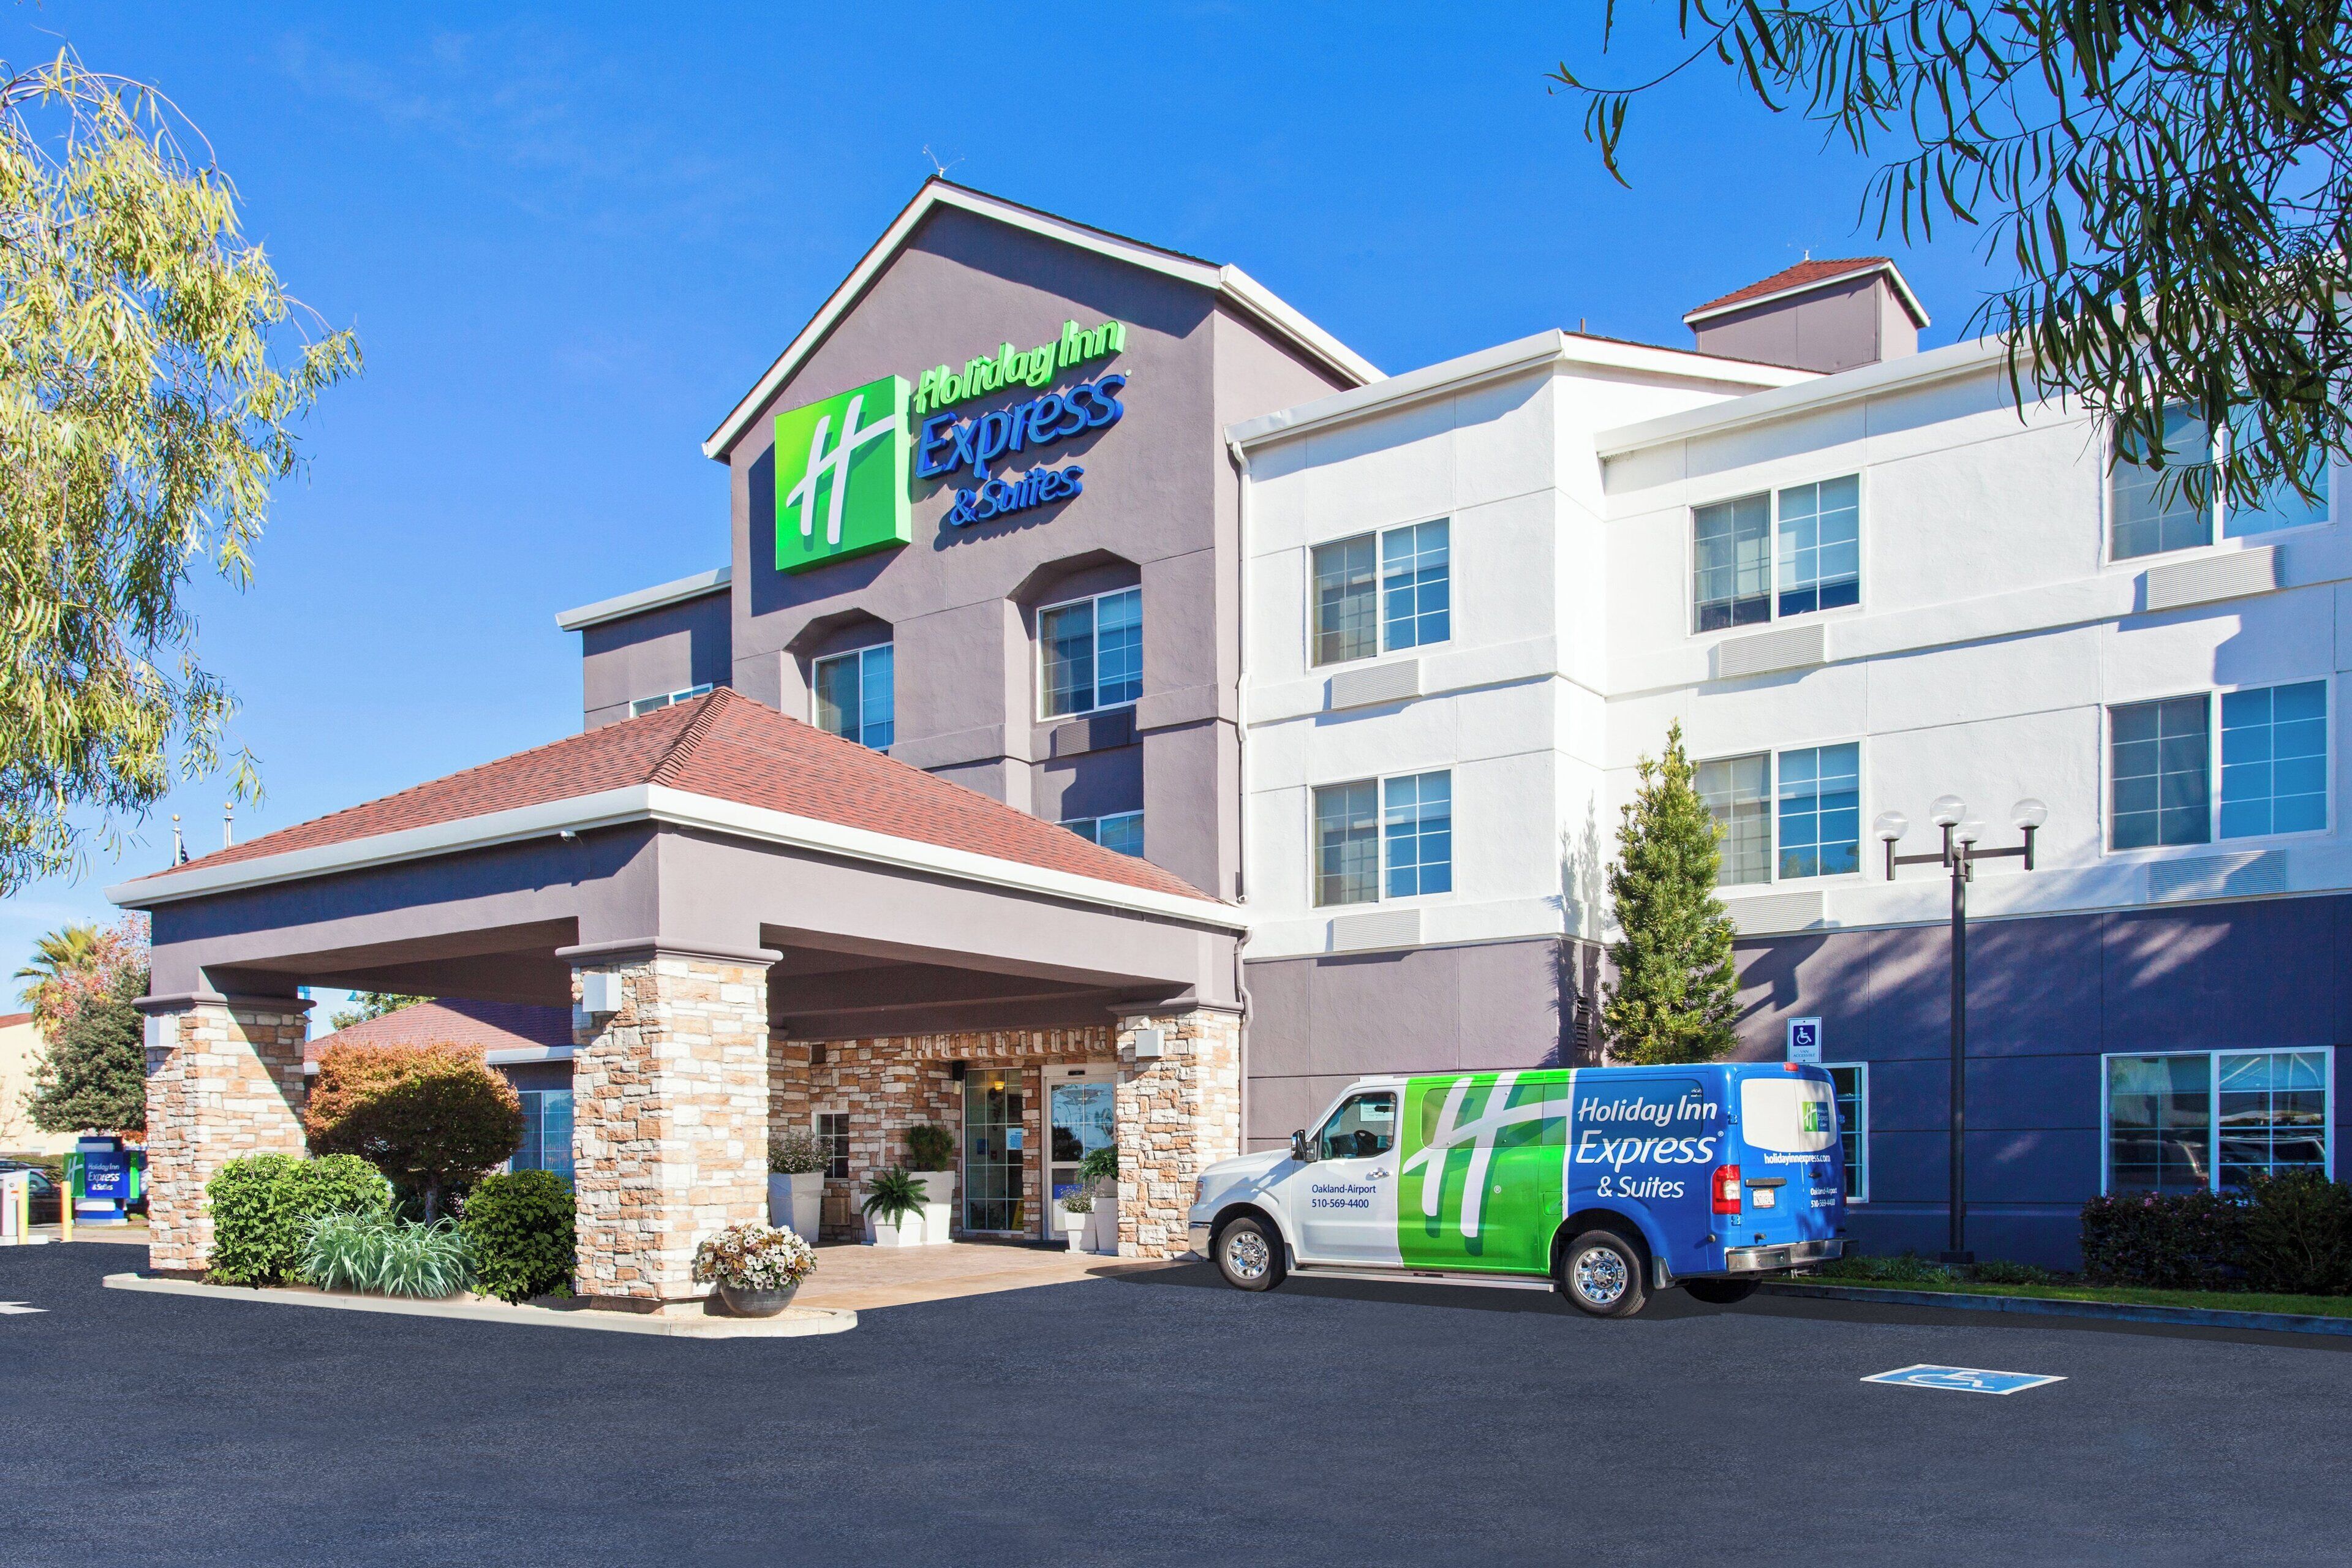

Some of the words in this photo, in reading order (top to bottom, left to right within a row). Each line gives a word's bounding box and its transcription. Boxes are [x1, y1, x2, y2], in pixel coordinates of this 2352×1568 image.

[913, 341, 1057, 414] Holiday
[1058, 319, 1126, 368] Inn
[915, 374, 1126, 481] Express
[950, 488, 979, 526] &
[979, 466, 1084, 518] Suites
[1577, 1096, 1674, 1127] Holiday
[1676, 1095, 1718, 1120] Inn
[1575, 1129, 1717, 1174] Express
[1763, 1153, 1831, 1166] holidayinnexpress.com
[88, 1163, 109, 1172] Holiday
[88, 1171, 121, 1183] Express
[1311, 1184, 1376, 1195] Oakland-Airport
[1597, 1175, 1613, 1198] &
[1617, 1176, 1685, 1199] Suites
[1810, 1186, 1838, 1196] Oakland-Airport
[1311, 1199, 1370, 1208] 510-569-4400
[1811, 1198, 1836, 1208] 510-569-4400
